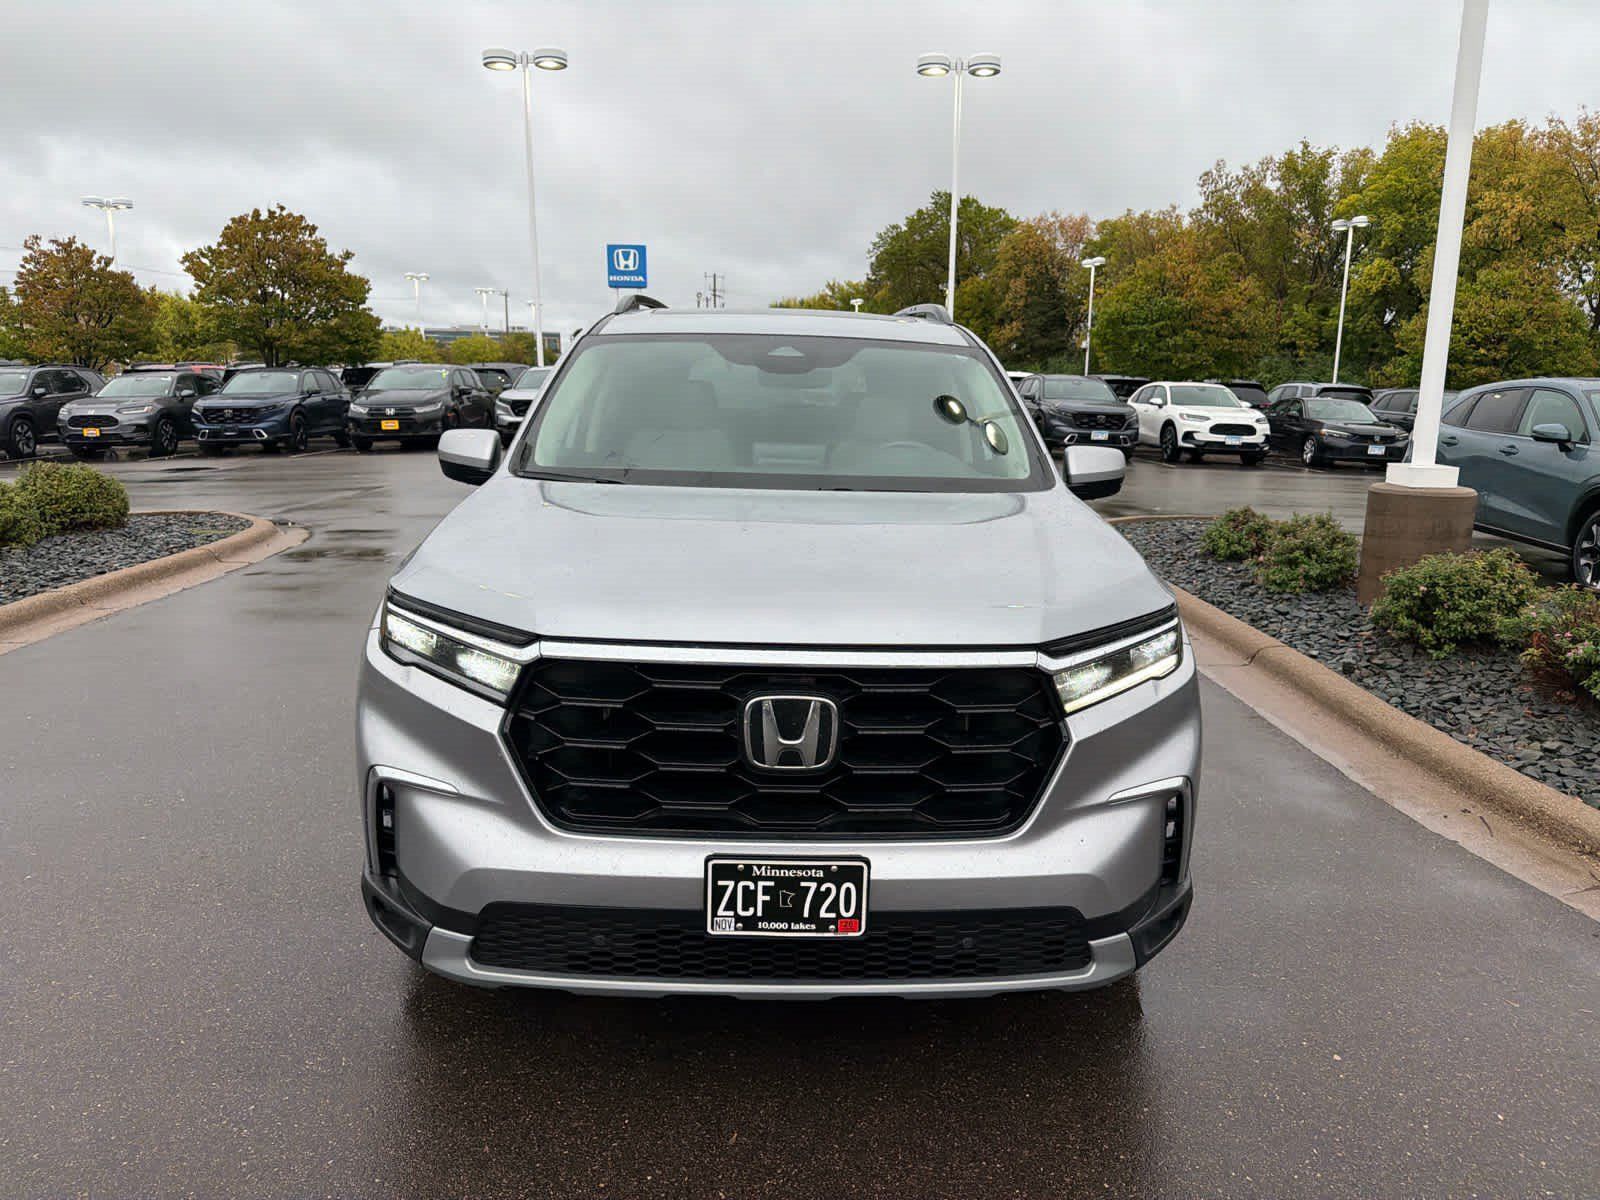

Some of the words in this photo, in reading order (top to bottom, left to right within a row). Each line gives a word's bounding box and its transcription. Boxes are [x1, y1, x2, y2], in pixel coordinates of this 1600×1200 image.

[752, 865, 825, 878] Minnesota
[716, 880, 775, 917] ZCF
[799, 881, 857, 918] 720
[714, 919, 733, 931] NOV
[757, 921, 789, 930] 10,000
[790, 921, 817, 930] lakes
